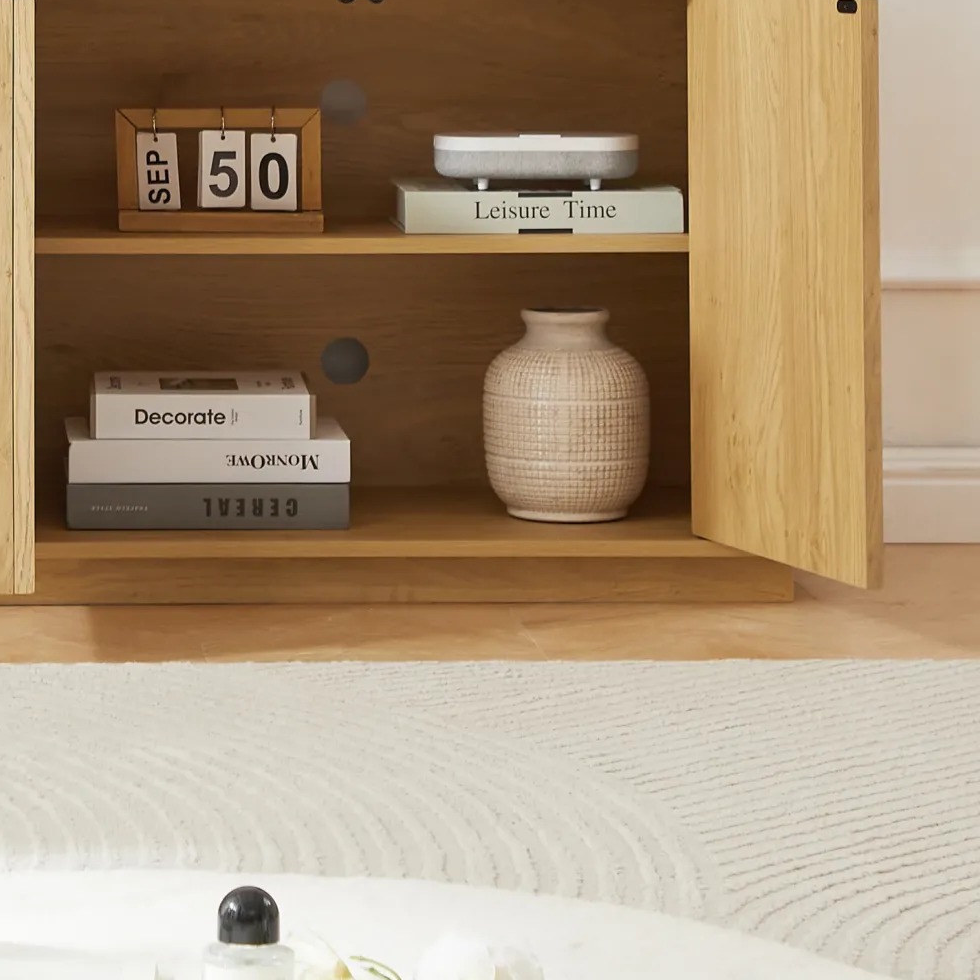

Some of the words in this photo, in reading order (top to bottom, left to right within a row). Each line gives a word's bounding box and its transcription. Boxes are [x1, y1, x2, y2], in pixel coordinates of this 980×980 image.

[146, 150, 172, 205] SEP
[474, 200, 551, 220] Leisure
[563, 200, 617, 219] Time
[134, 408, 226, 425] Decorate
[202, 497, 298, 517] CEREAL
